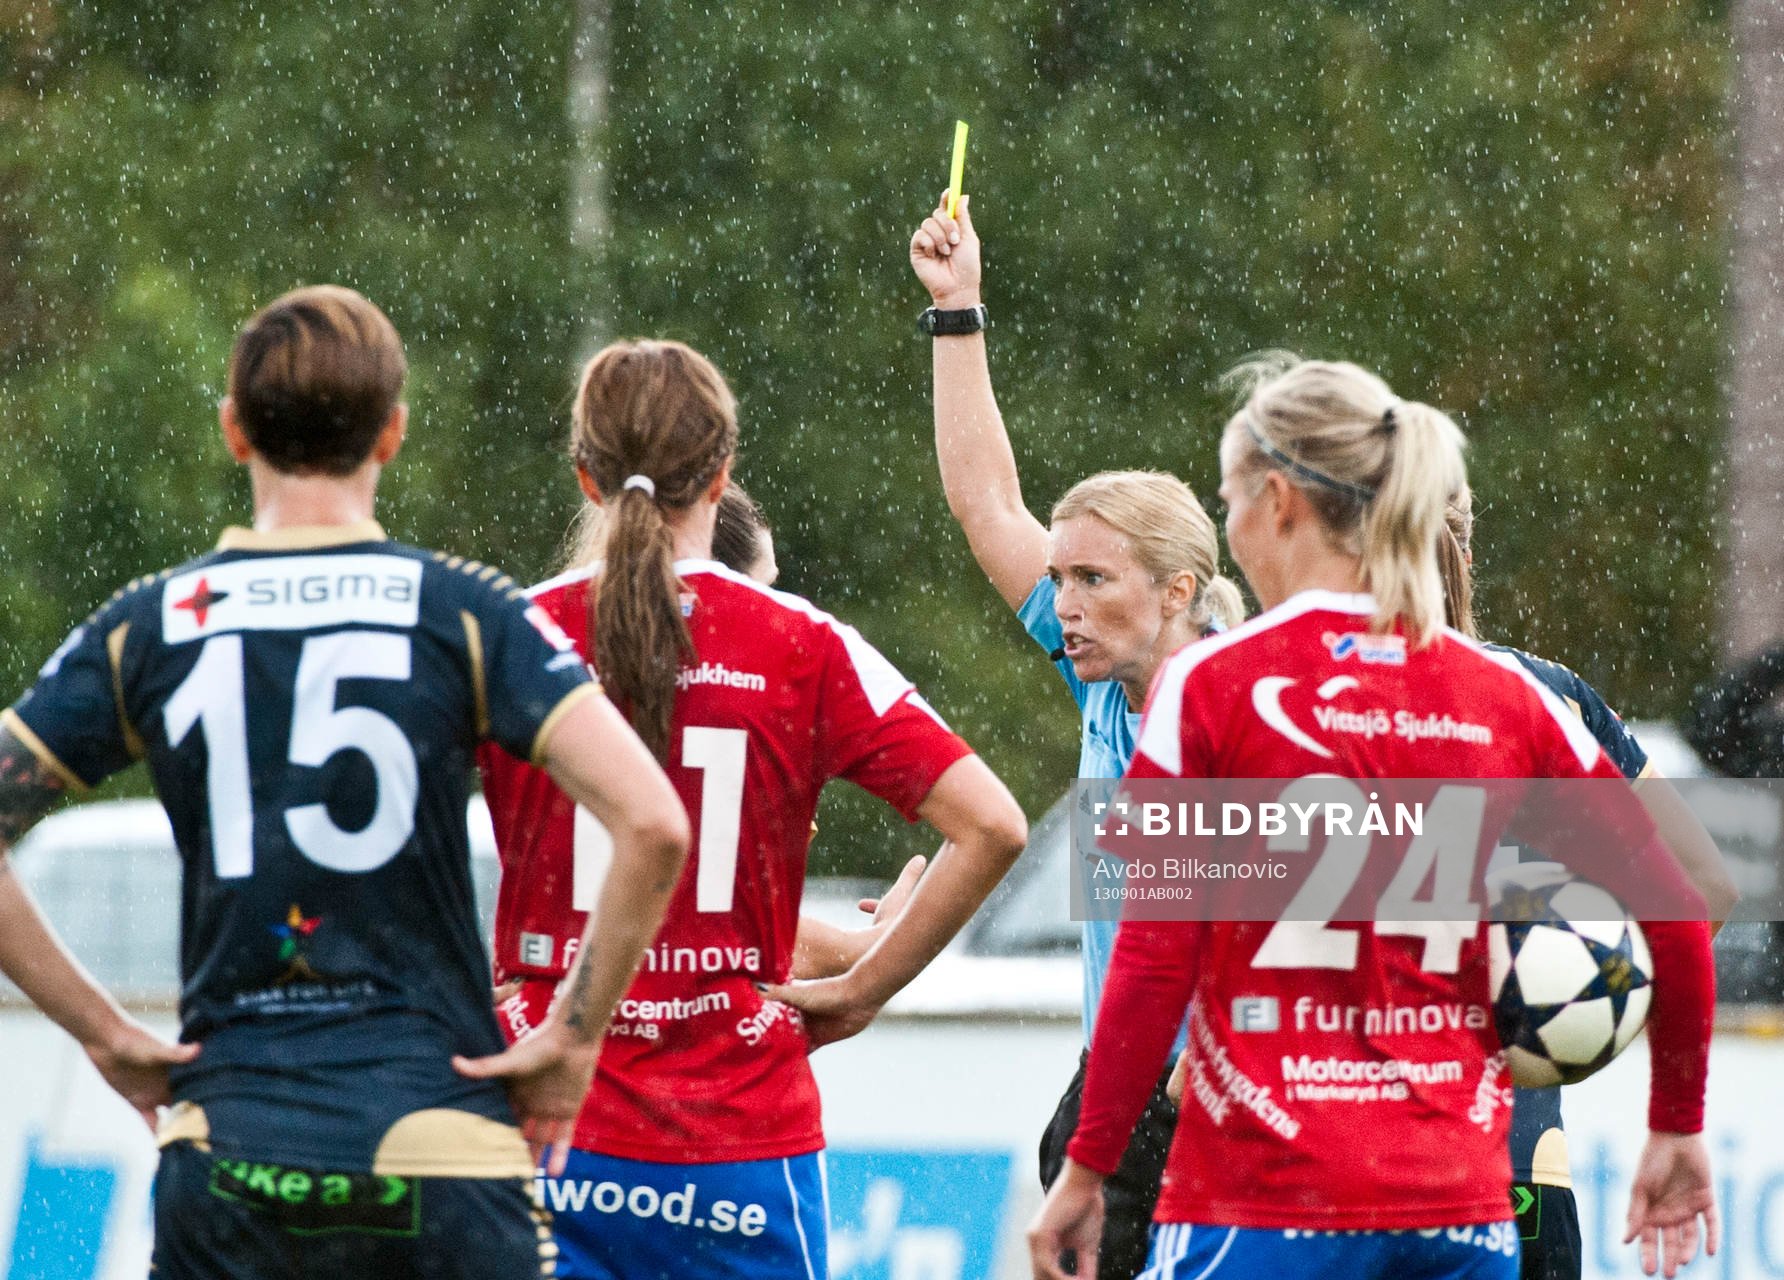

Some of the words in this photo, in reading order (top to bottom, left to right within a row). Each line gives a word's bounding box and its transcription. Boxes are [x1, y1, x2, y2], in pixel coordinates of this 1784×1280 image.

[1393, 710, 1494, 747] Sjukhem
[162, 630, 419, 879] 15
[1250, 772, 1487, 975] 24
[562, 938, 761, 973] fninova
[612, 991, 731, 1021] centrum
[1294, 996, 1488, 1036] furninova
[1381, 1081, 1410, 1101] AB
[534, 1167, 767, 1237] iwood.se
